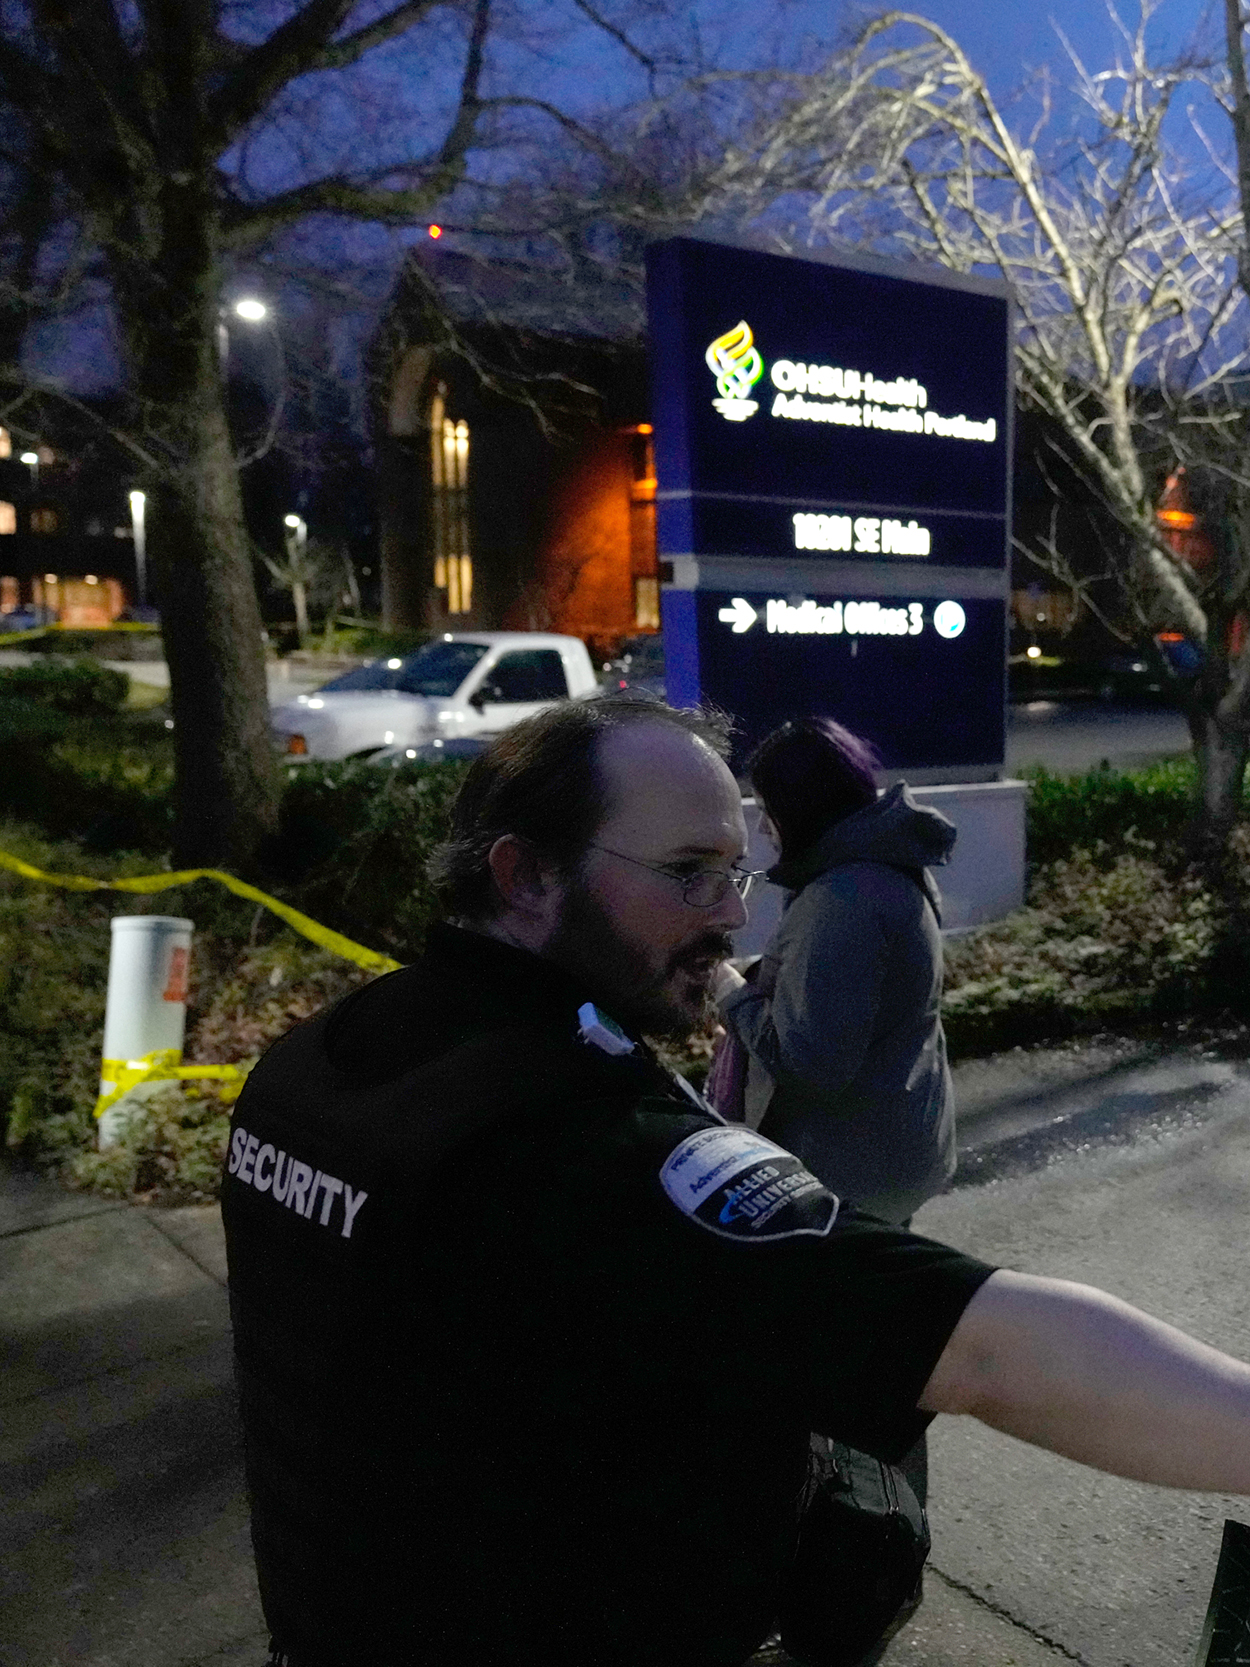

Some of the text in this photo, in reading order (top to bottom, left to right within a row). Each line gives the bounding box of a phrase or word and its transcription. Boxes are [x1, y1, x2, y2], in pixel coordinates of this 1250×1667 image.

[852, 370, 927, 408] Health
[772, 393, 996, 442] Adventist Health Portland
[854, 517, 880, 552] SE
[882, 519, 930, 555] Main
[767, 600, 843, 633] Medical
[909, 603, 923, 635] 3
[229, 1127, 368, 1238] SECURITY
[724, 1166, 780, 1204] ALLIED
[739, 1171, 819, 1217] UNIVERSA
